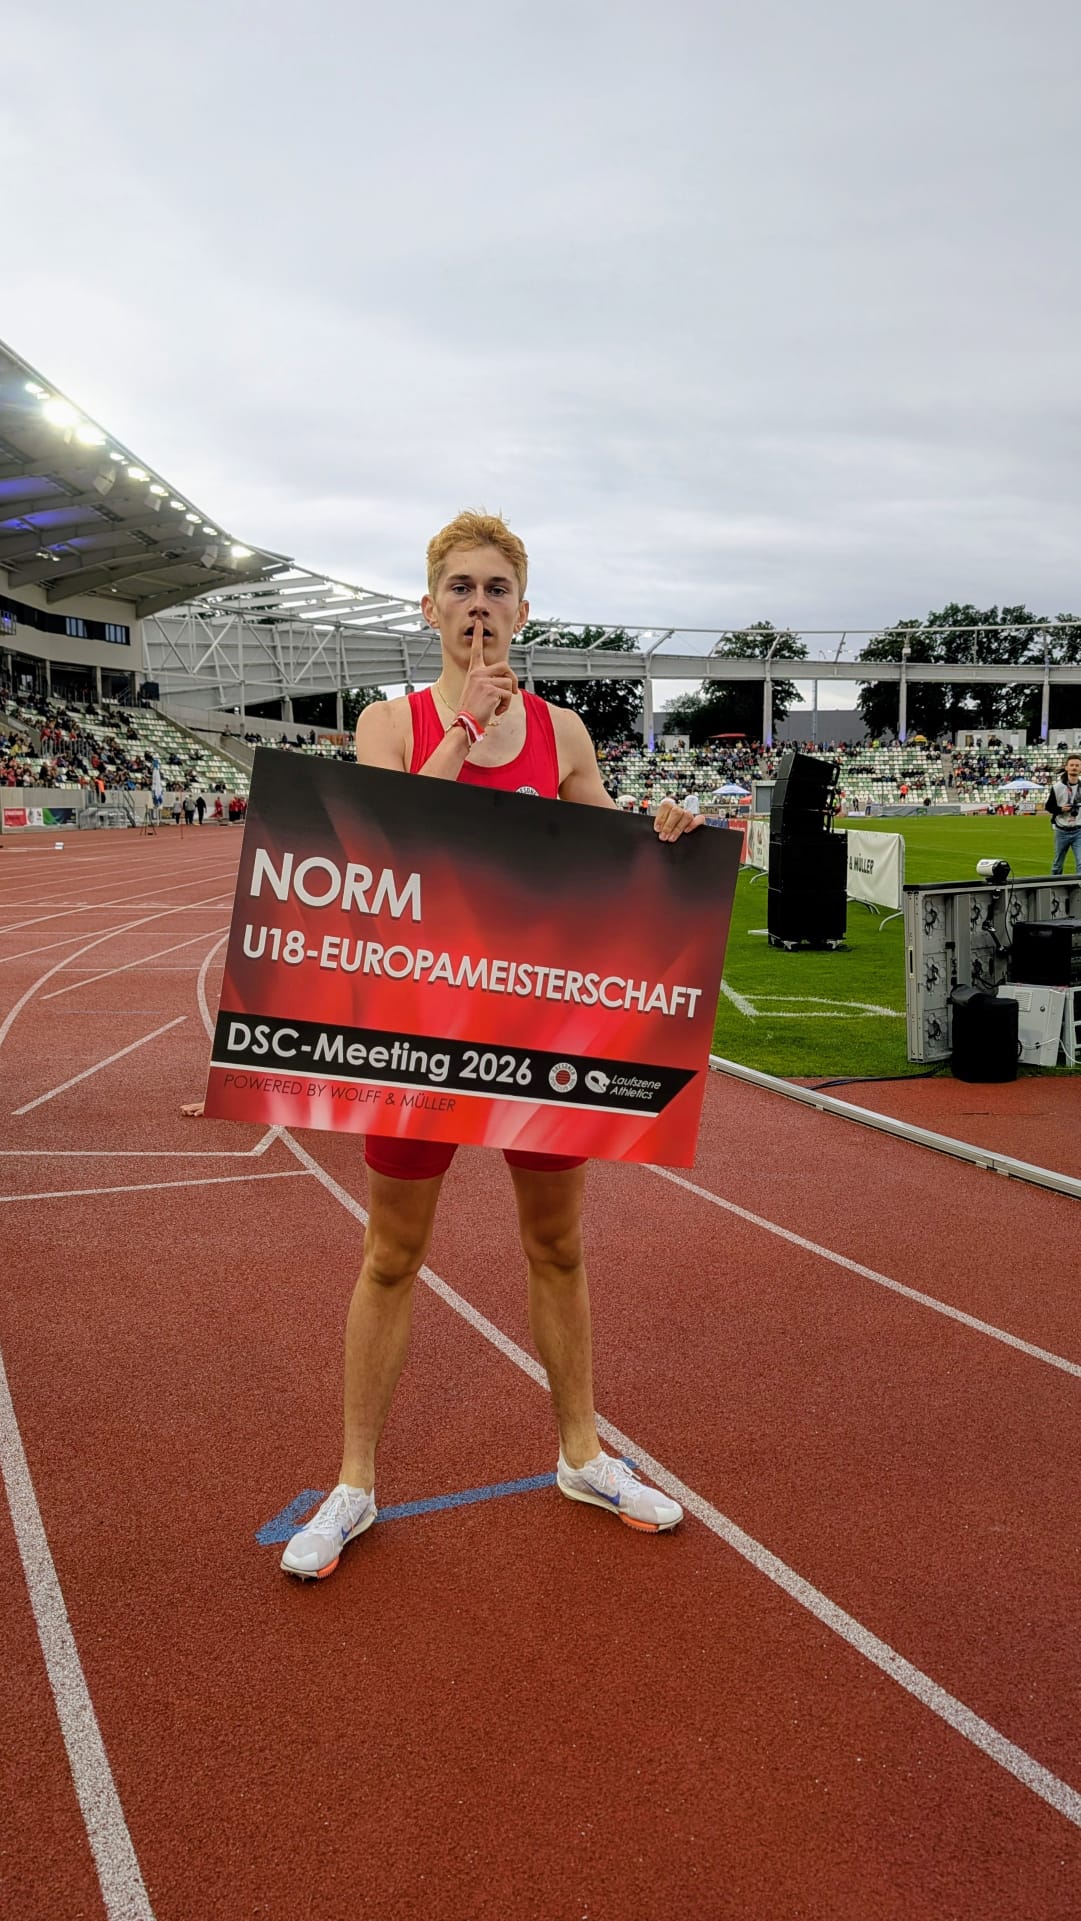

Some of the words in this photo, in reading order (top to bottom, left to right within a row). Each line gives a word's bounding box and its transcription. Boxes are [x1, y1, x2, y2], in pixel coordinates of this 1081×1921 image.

[854, 853, 874, 874] MÜLLER
[250, 848, 422, 922] NORM
[243, 924, 702, 1018] U18-EUROPAMEISTERSCHAFT
[227, 1021, 451, 1082] DSC-Meeting
[458, 1050, 532, 1086] 2026
[223, 1074, 302, 1096] POWERED
[306, 1083, 327, 1098] BY
[331, 1087, 382, 1105] WOLFF
[384, 1092, 396, 1105] &
[400, 1093, 456, 1113] MÜLLER
[610, 1086, 654, 1100] Athletics
[611, 1075, 662, 1090] Laufszene
